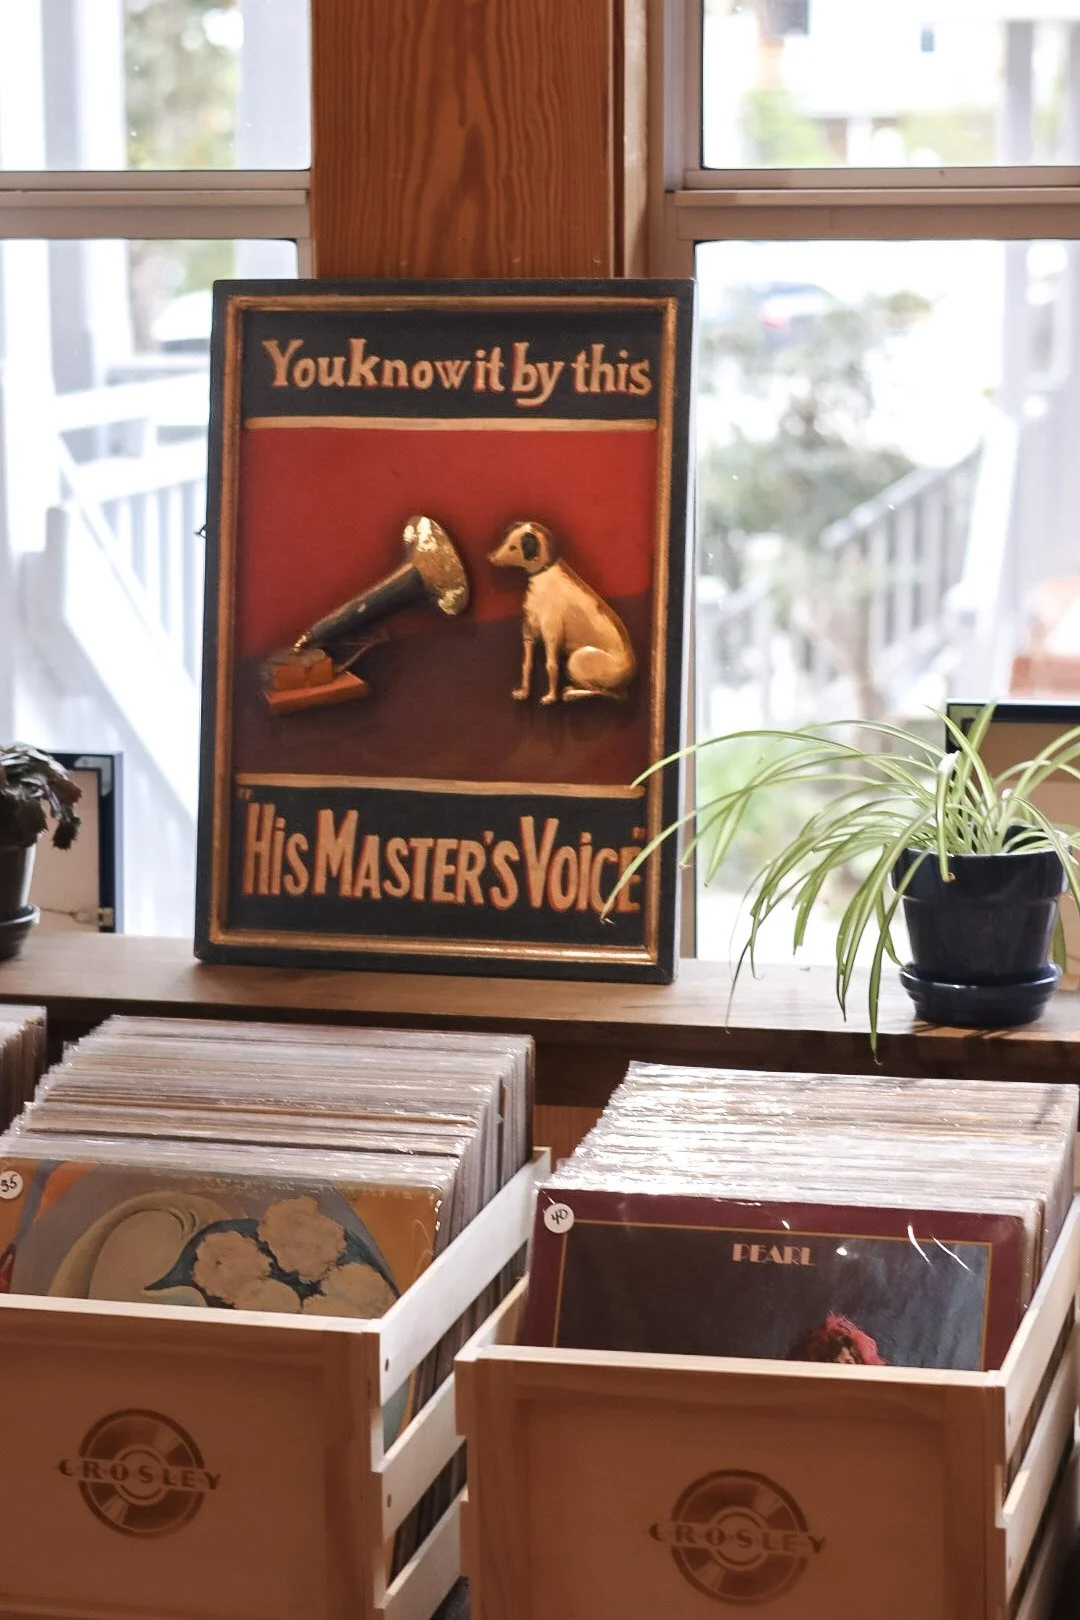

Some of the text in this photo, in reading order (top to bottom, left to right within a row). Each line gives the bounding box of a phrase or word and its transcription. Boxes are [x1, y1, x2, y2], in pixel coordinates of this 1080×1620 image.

[261, 338, 652, 407] You know it by this
[550, 1209, 569, 1225] 40
[732, 1243, 816, 1266] PEARL
[57, 1458, 222, 1491] CROSLEY
[648, 1522, 826, 1555] CROSLEY
